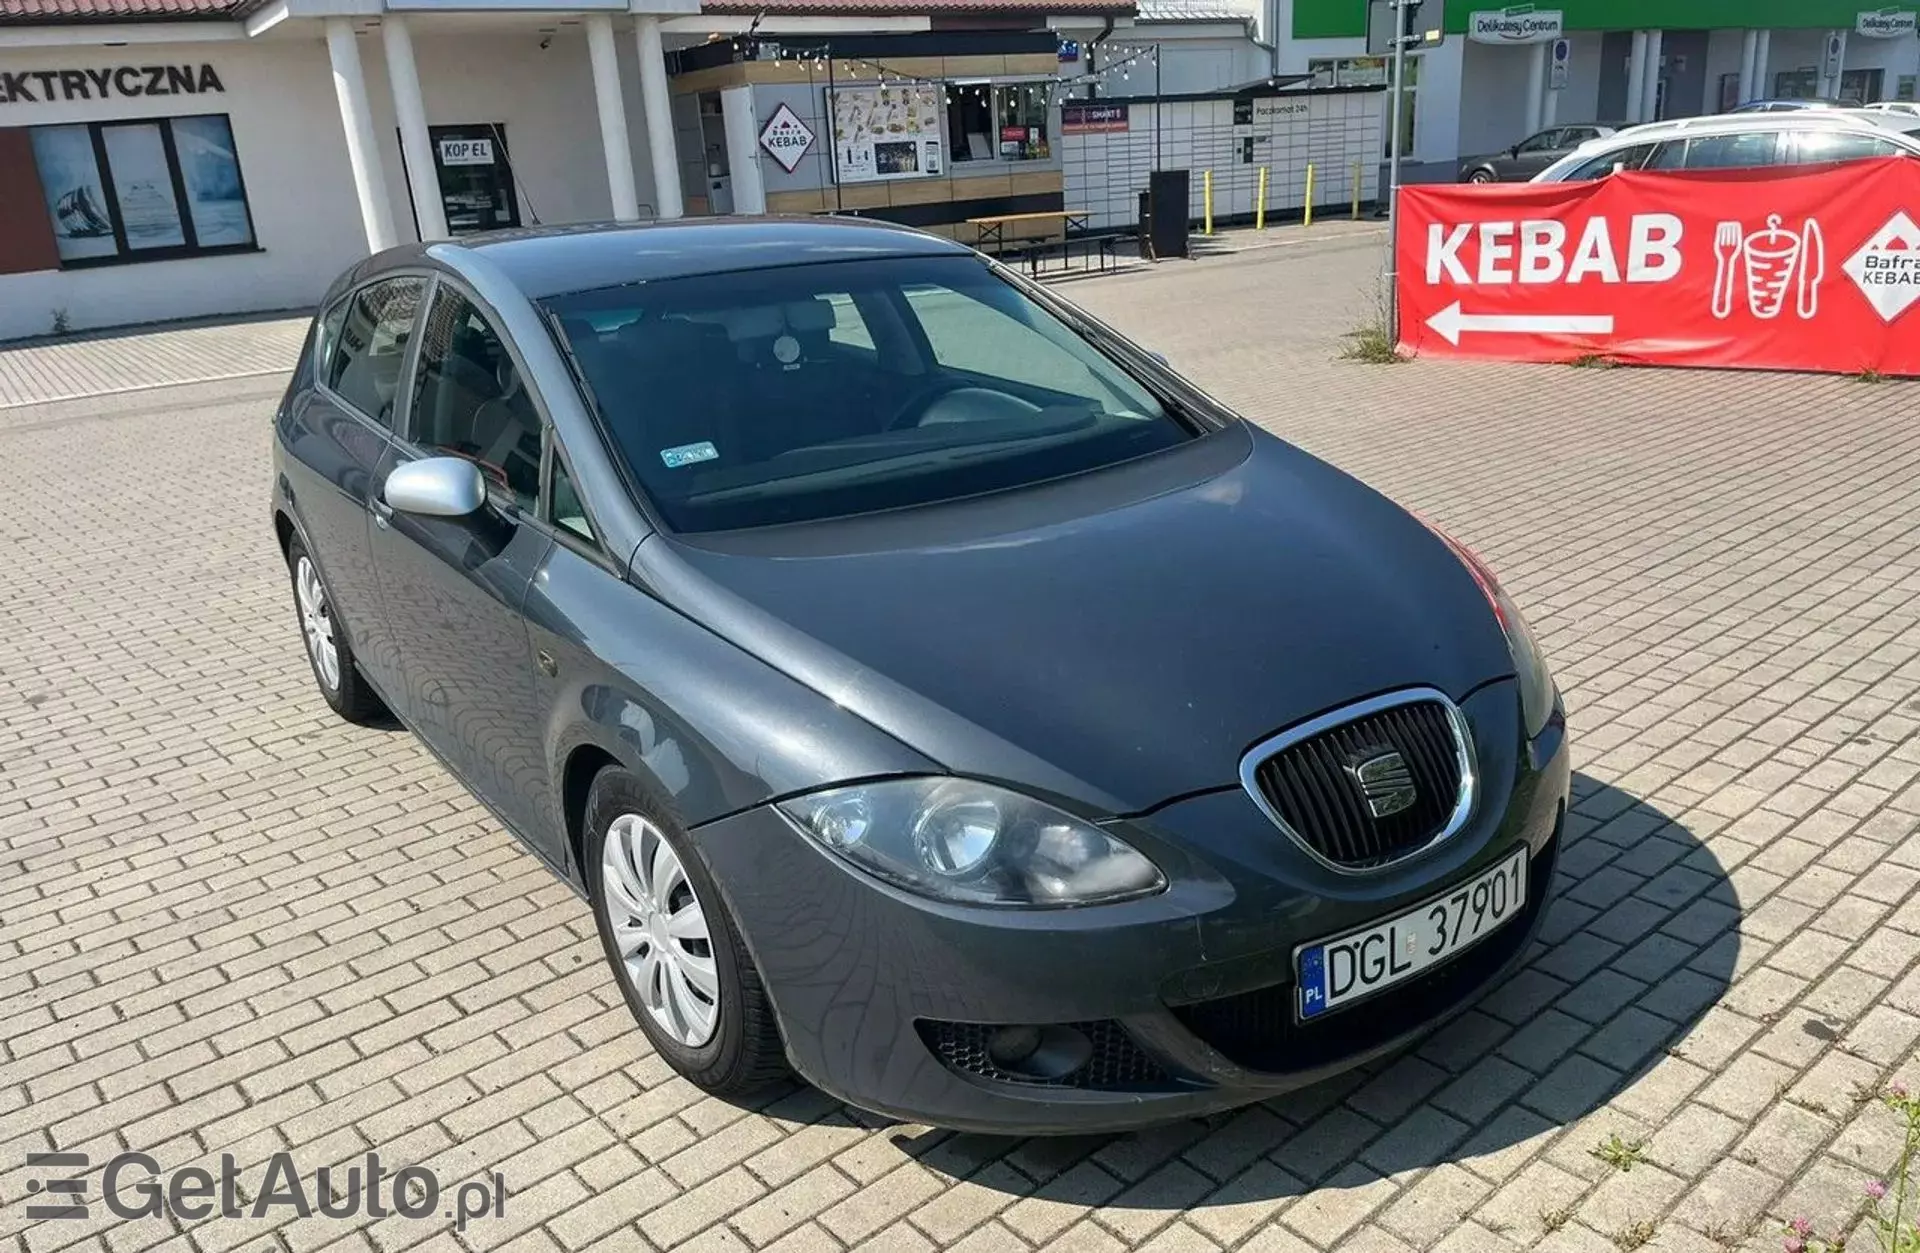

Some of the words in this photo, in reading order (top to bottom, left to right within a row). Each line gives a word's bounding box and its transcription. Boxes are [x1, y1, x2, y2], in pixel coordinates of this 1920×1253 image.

[1477, 19, 1522, 35] Delikatesy
[1523, 19, 1558, 31] Centrum
[768, 136, 808, 147] KEBAB
[445, 143, 469, 157] KOP
[1426, 213, 1684, 284] KEBAB
[1329, 927, 1411, 999] DGL
[1428, 857, 1520, 956] 37901
[1306, 986, 1322, 1003] PL
